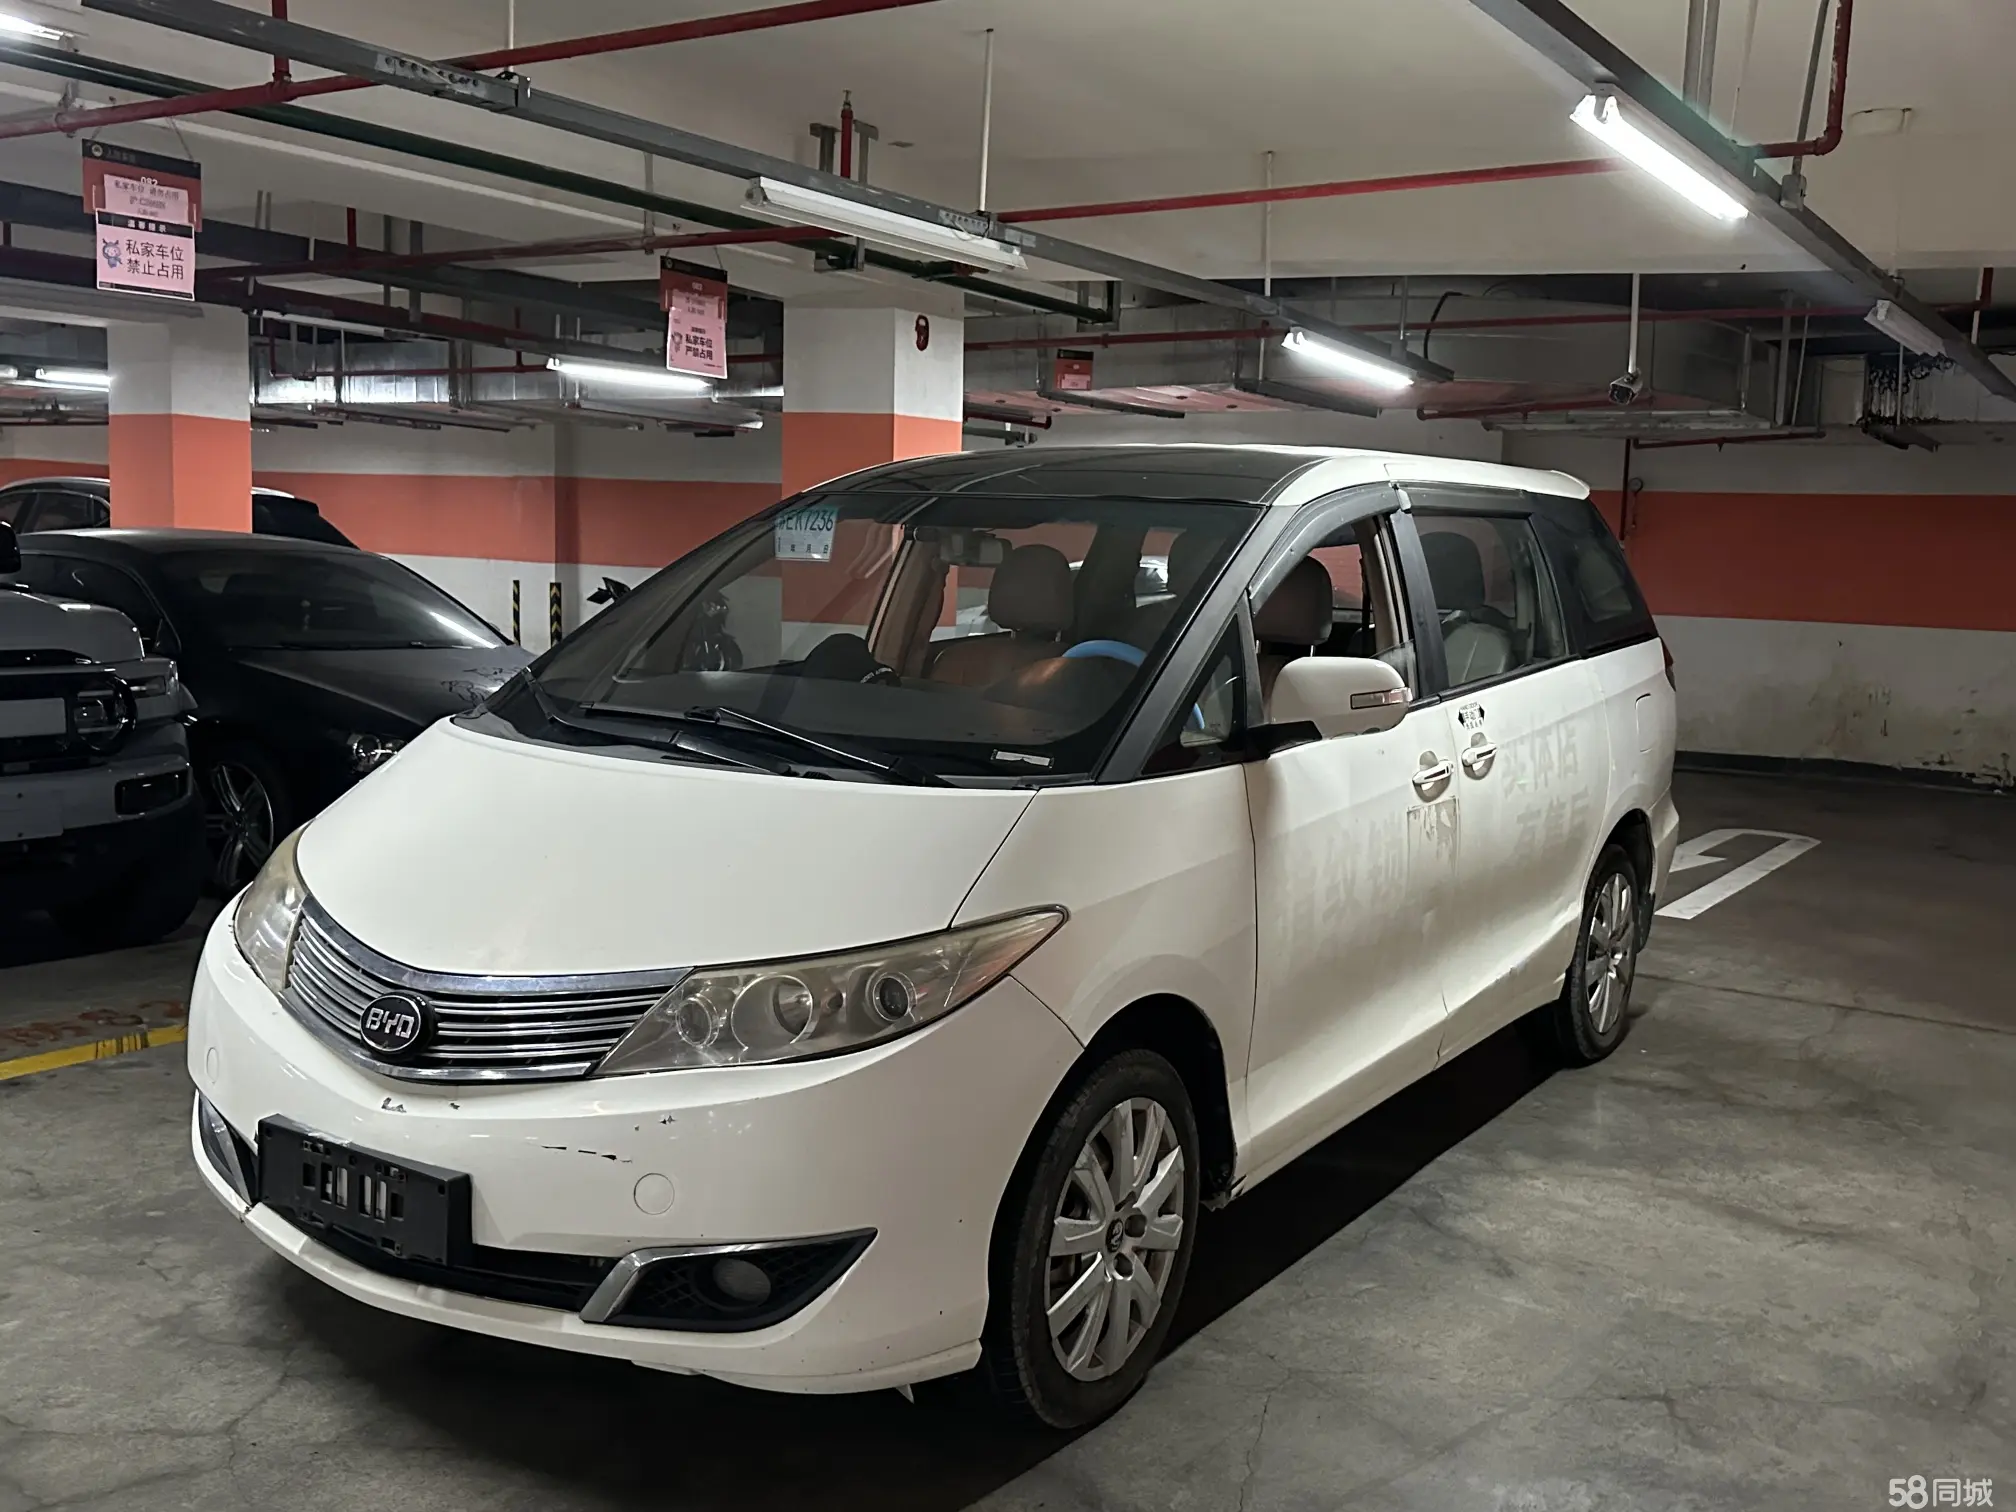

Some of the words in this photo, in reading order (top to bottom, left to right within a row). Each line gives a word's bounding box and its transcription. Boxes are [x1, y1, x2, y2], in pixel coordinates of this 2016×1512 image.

[125, 239, 184, 262] 私家车位
[126, 258, 184, 280] 禁止占用
[685, 333, 713, 349] 私家车位
[685, 345, 713, 361] 严禁占用
[366, 1007, 415, 1038] BYD
